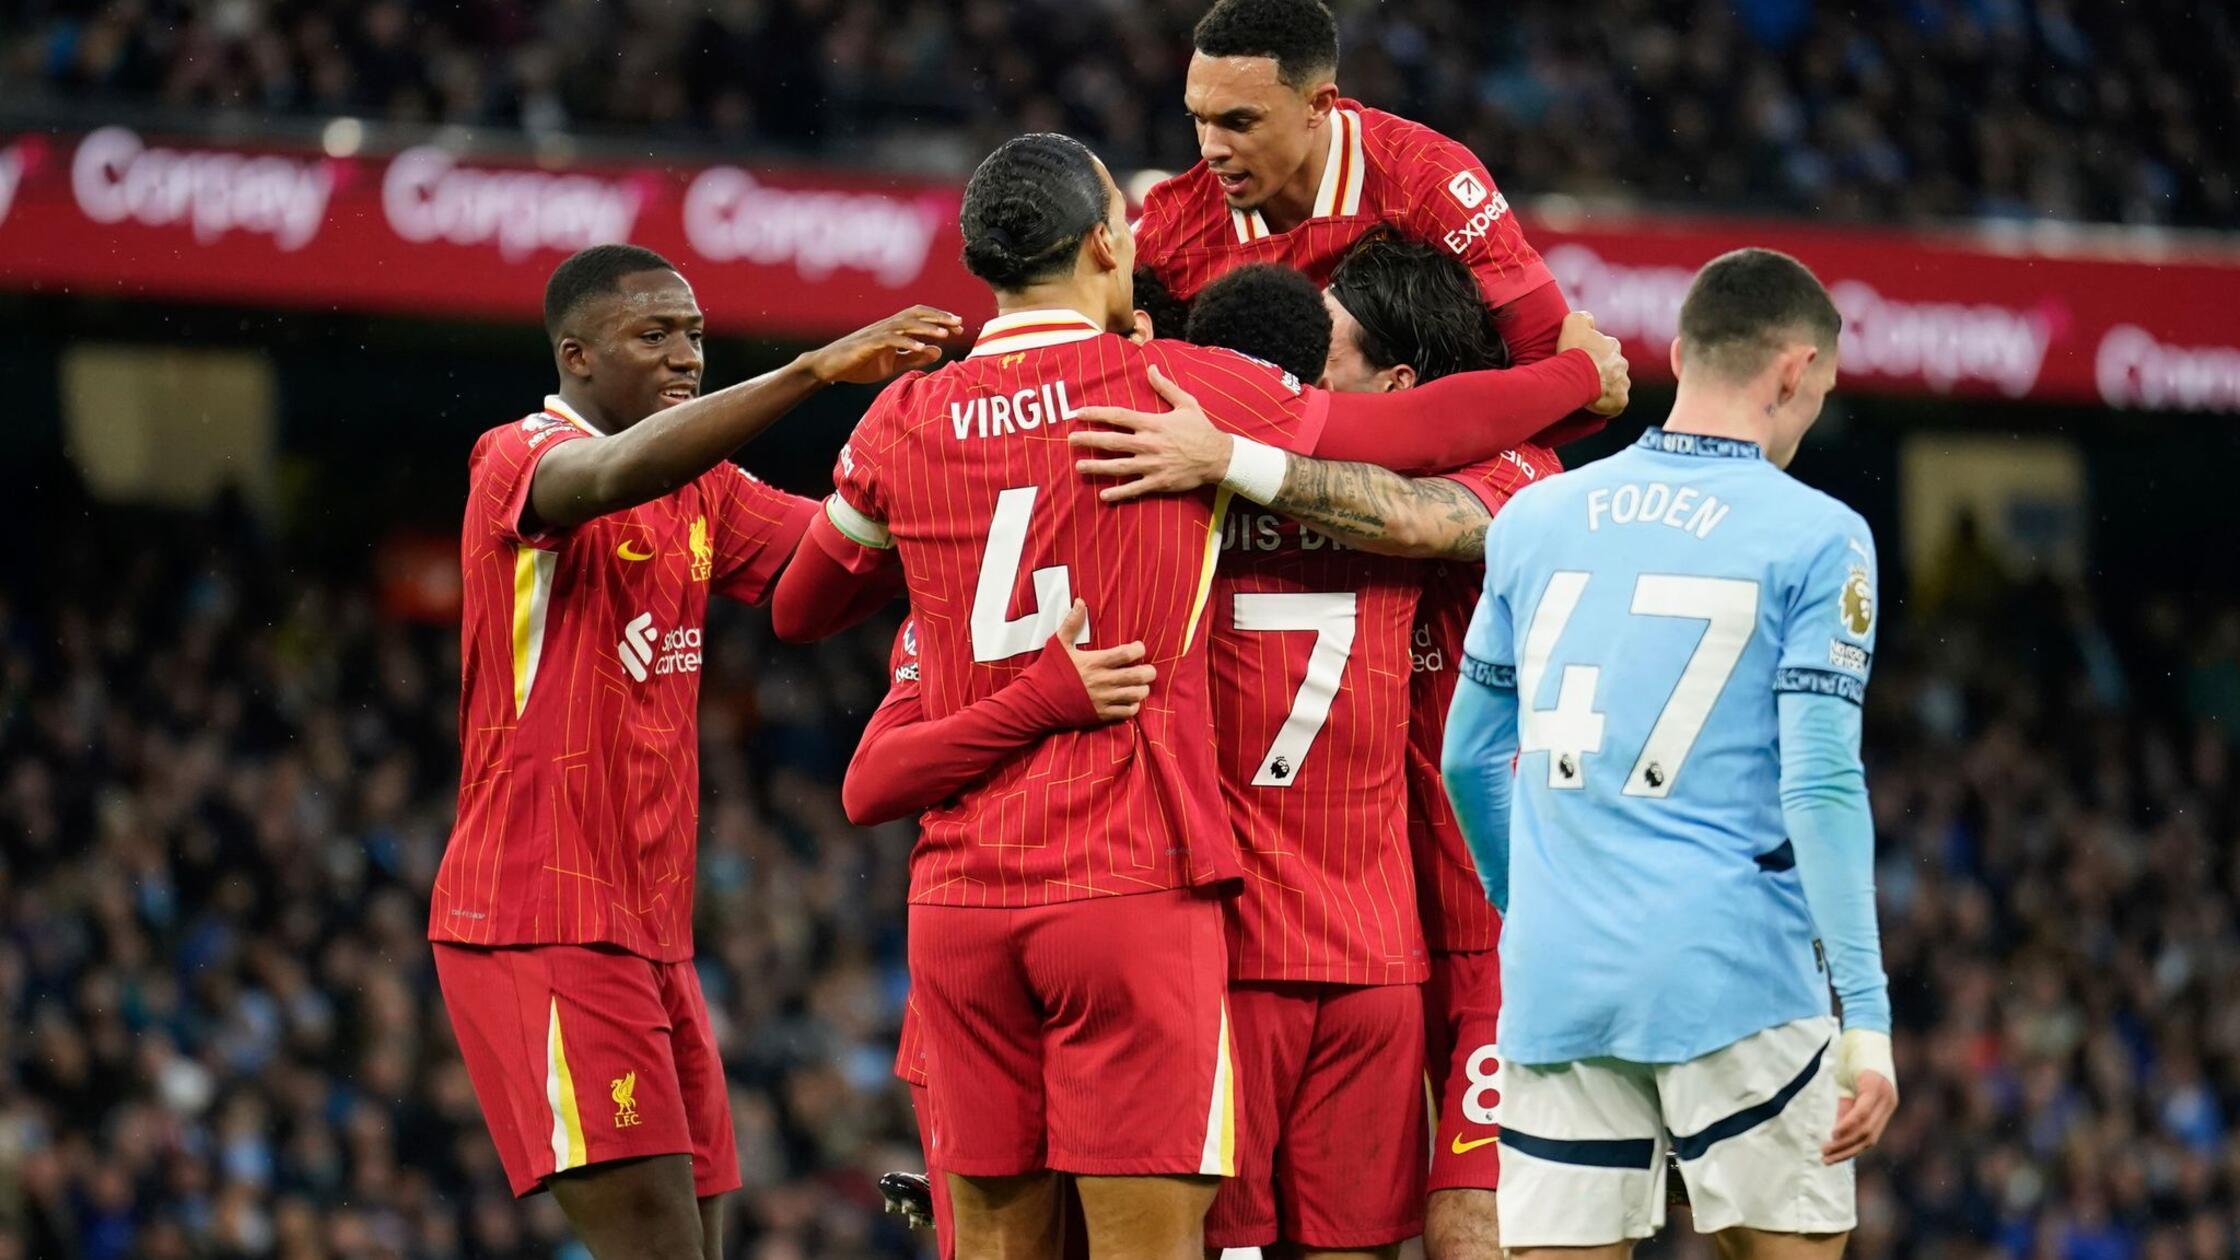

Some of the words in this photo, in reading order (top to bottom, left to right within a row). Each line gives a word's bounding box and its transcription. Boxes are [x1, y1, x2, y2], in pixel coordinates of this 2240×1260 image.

[951, 380, 1078, 440] VIRGIL
[970, 486, 1091, 662] 4
[1587, 481, 1729, 539] FODEN
[1233, 592, 1356, 787] 7
[1519, 570, 1759, 798] 47
[1462, 1044, 1504, 1125] 8
